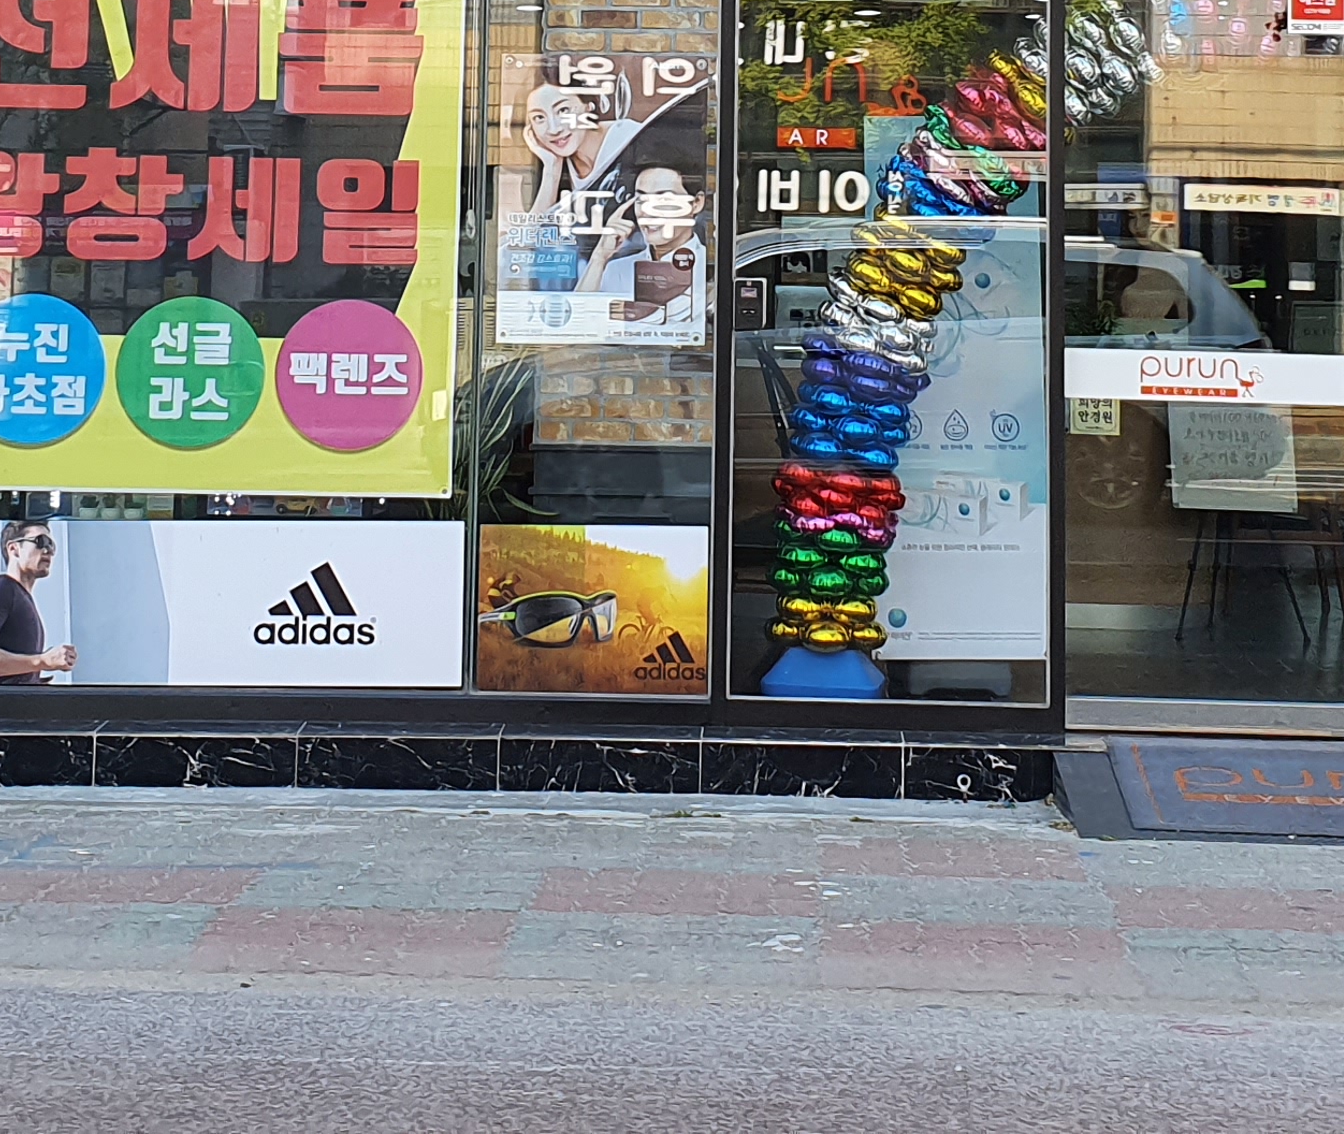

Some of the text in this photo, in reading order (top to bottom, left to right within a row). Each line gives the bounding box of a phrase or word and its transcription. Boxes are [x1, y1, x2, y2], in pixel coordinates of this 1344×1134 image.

[150, 321, 232, 364] 선글
[288, 352, 409, 396] 팩렌즈
[1140, 356, 1239, 382] purun
[149, 379, 229, 421] 라스
[1152, 386, 1227, 396] EYEWEAR
[1078, 410, 1113, 424] 안경원
[254, 615, 376, 646] adidas
[634, 663, 706, 682] adidas
